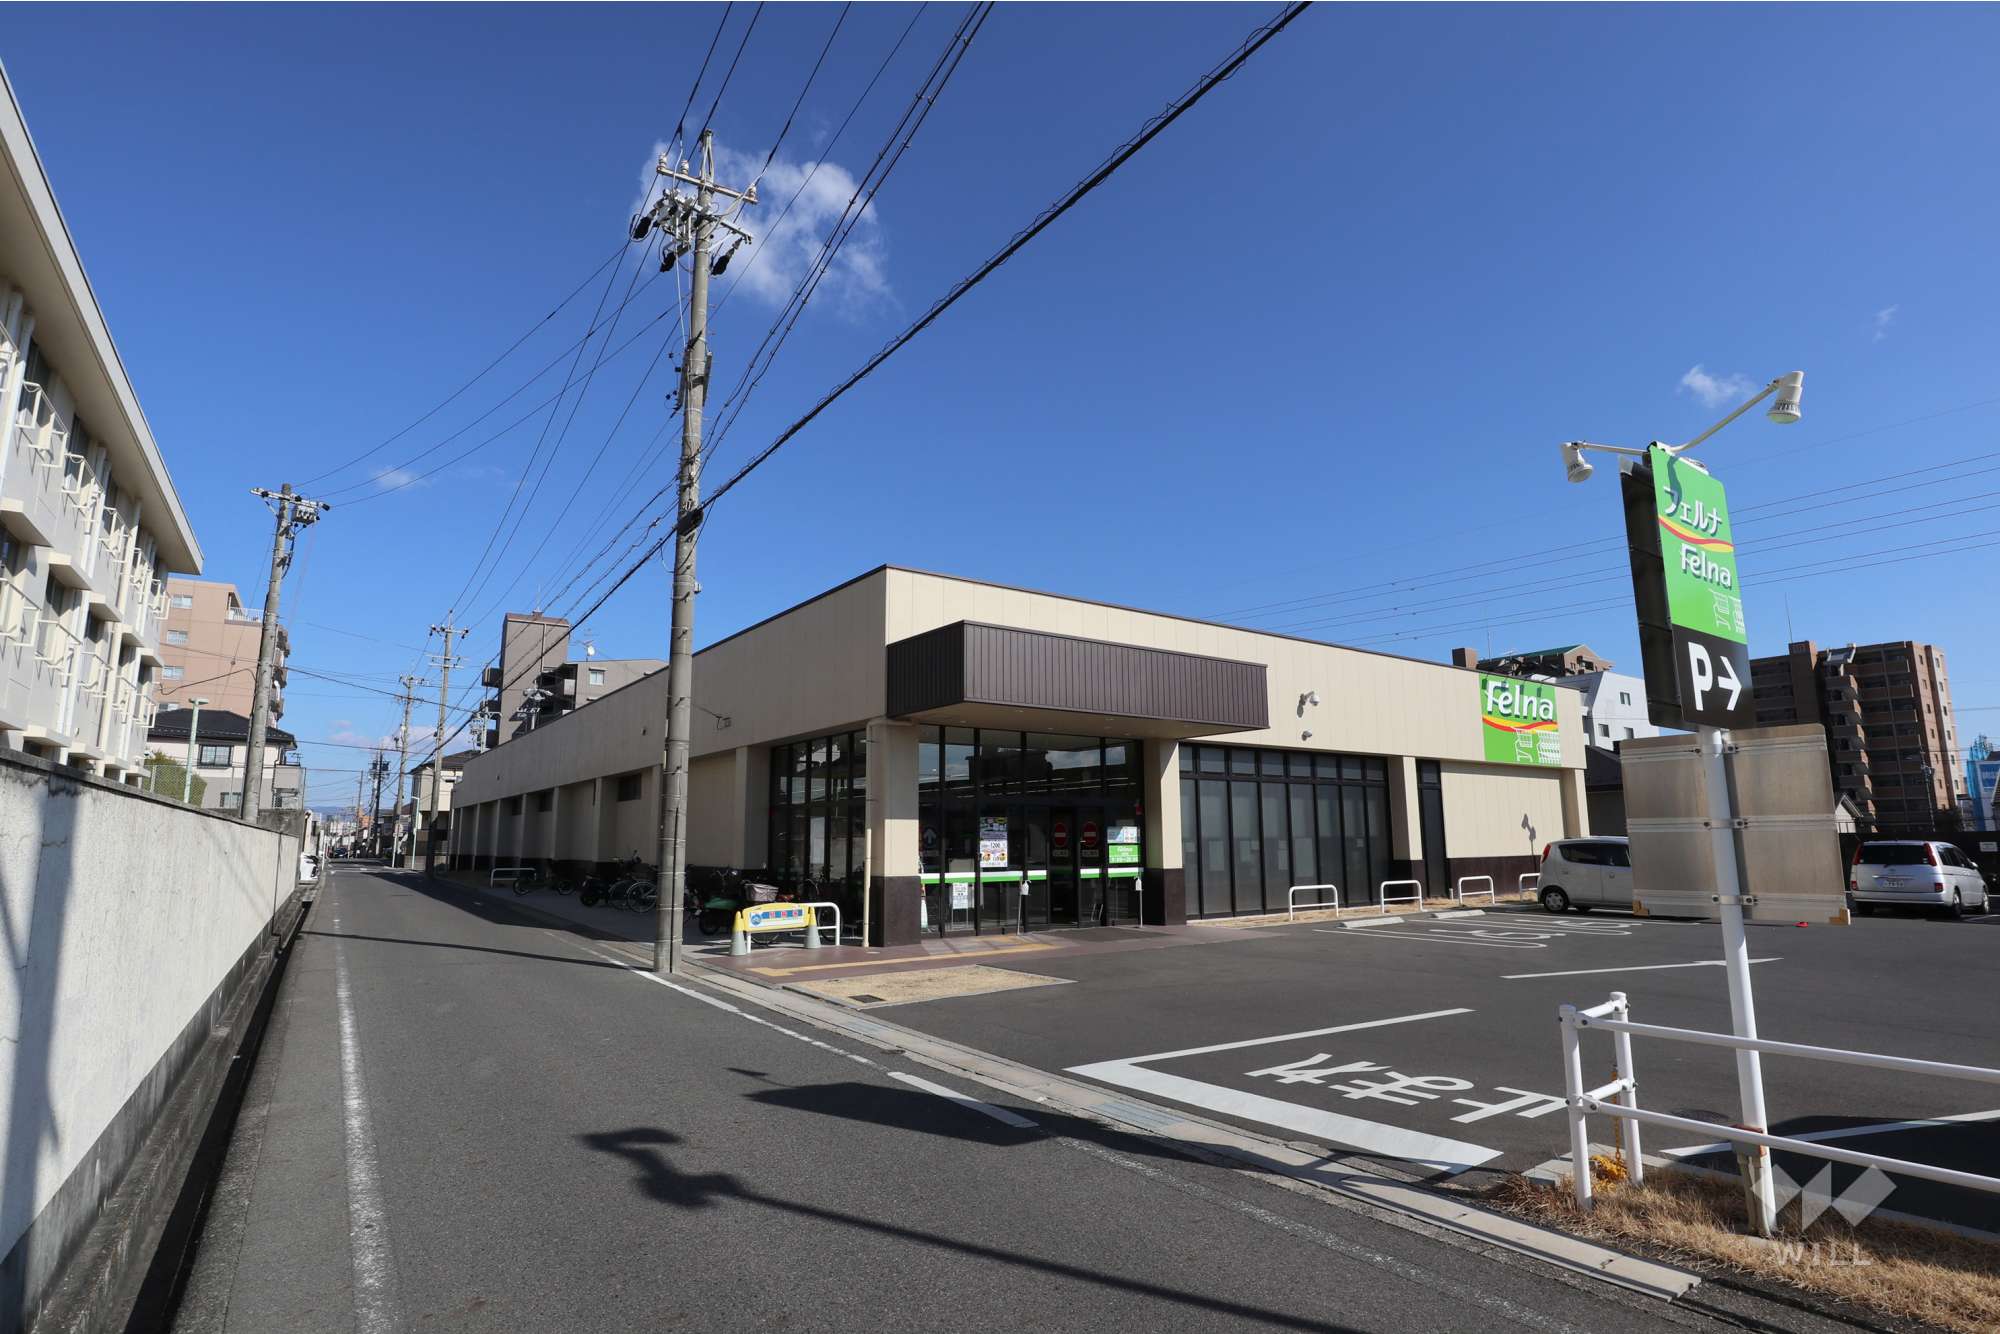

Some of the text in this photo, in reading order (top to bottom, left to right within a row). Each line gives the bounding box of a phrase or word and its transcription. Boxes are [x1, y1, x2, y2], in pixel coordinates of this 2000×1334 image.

[1662, 486, 1723, 537] フェルナ
[1679, 543, 1732, 589] Felna
[1483, 680, 1554, 721] Felna
[1687, 641, 1713, 711] P
[1244, 1052, 1568, 1124] 止まれ
